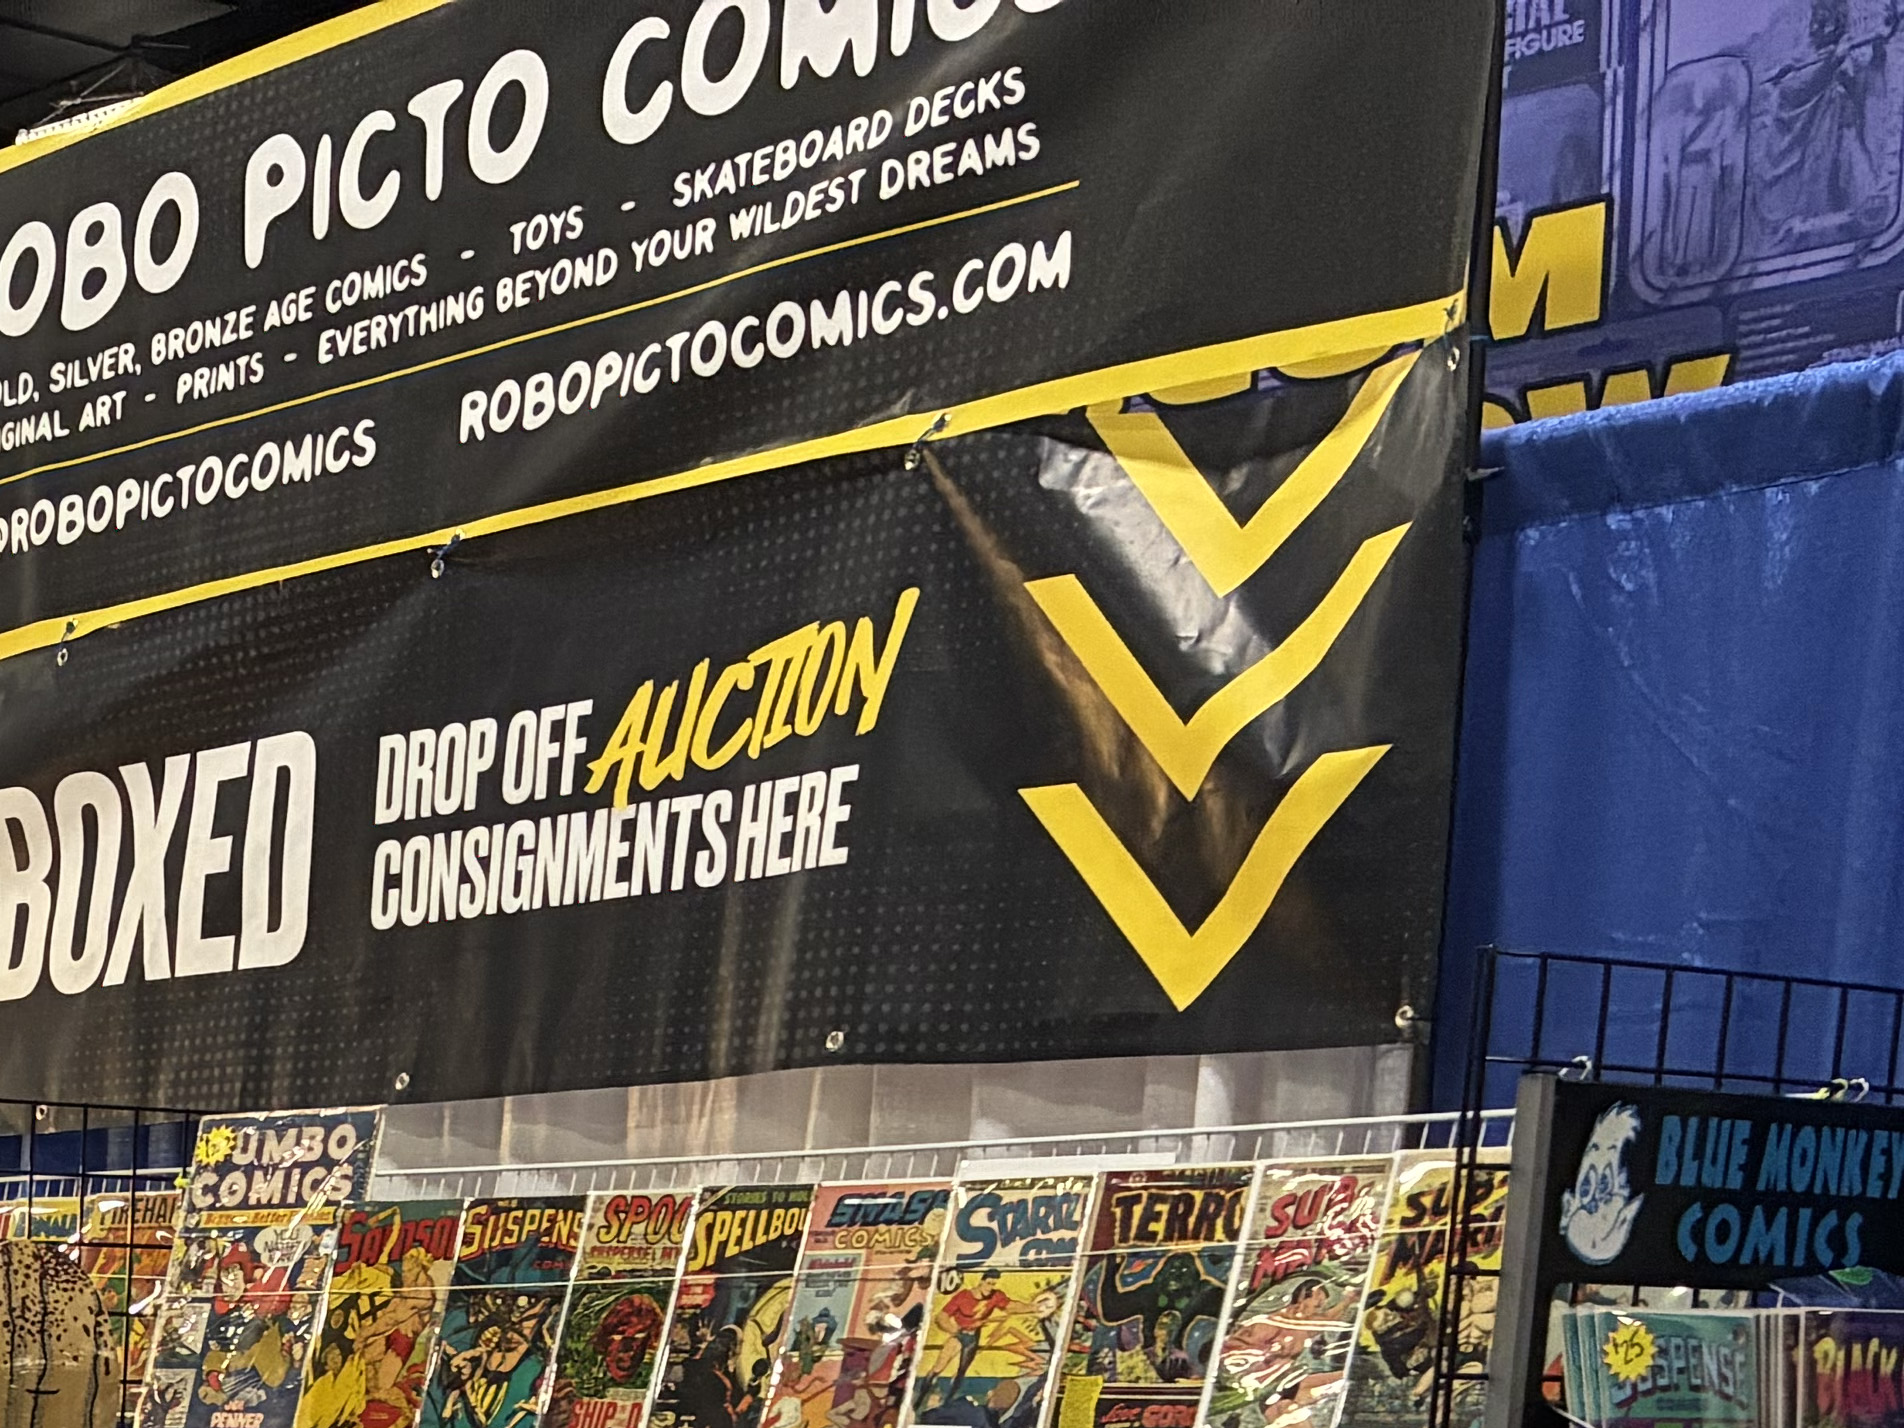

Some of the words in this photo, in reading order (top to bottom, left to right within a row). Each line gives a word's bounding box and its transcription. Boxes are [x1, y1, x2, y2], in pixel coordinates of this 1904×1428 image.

[245, 51, 548, 269] PICTO
[604, 0, 1068, 145] COM
[50, 347, 142, 399] SILVER,
[152, 317, 256, 369] BRONZE
[263, 298, 315, 340] AGE
[324, 259, 428, 315] COMICS
[510, 210, 583, 256] TOYS
[673, 110, 891, 208] SKATEBOARD
[904, 69, 1027, 137] DECKS
[81, 396, 124, 437] ART
[177, 353, 263, 406] PRINTS
[317, 291, 485, 368] EVERYTHING
[495, 254, 617, 317] BEYOND
[629, 220, 715, 279] YOUR
[728, 173, 868, 252] WILDEST
[878, 122, 1042, 208] DREAMS
[458, 232, 1076, 444] ROBOPICTOCOMICS.COM
[373, 718, 496, 826] DROP
[502, 698, 592, 804] OFF
[587, 589, 918, 812] AUCTION
[371, 783, 733, 933] CONSIGNMENTS
[737, 765, 862, 882] HERE
[192, 1164, 353, 1208] COMICS
[833, 1228, 937, 1250] COMICS
[1655, 1115, 1751, 1189] BLUE
[1758, 1125, 1904, 1200] MONKEY
[1677, 1204, 1863, 1269] COMICS
